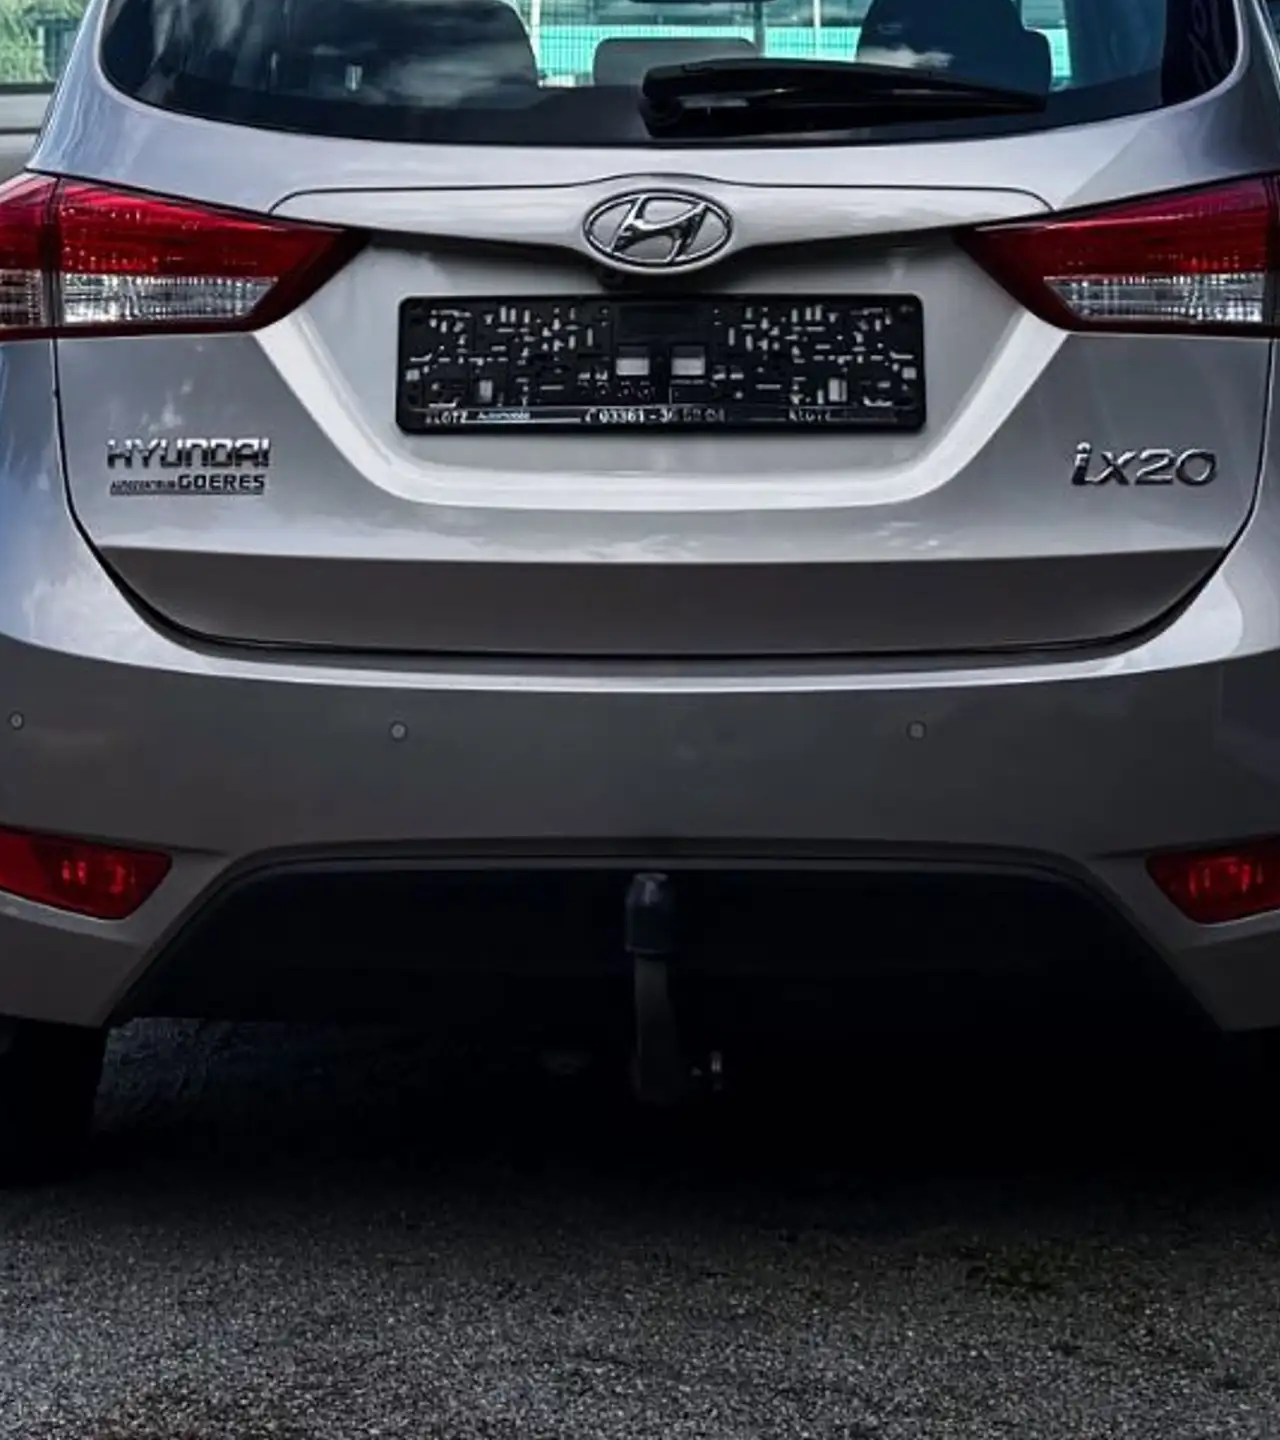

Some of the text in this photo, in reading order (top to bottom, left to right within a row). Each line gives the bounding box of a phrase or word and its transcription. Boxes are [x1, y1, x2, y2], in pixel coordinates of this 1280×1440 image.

[107, 438, 271, 468] HYUNDAI
[1072, 441, 1217, 486] ix20
[178, 473, 266, 490] GOERES
